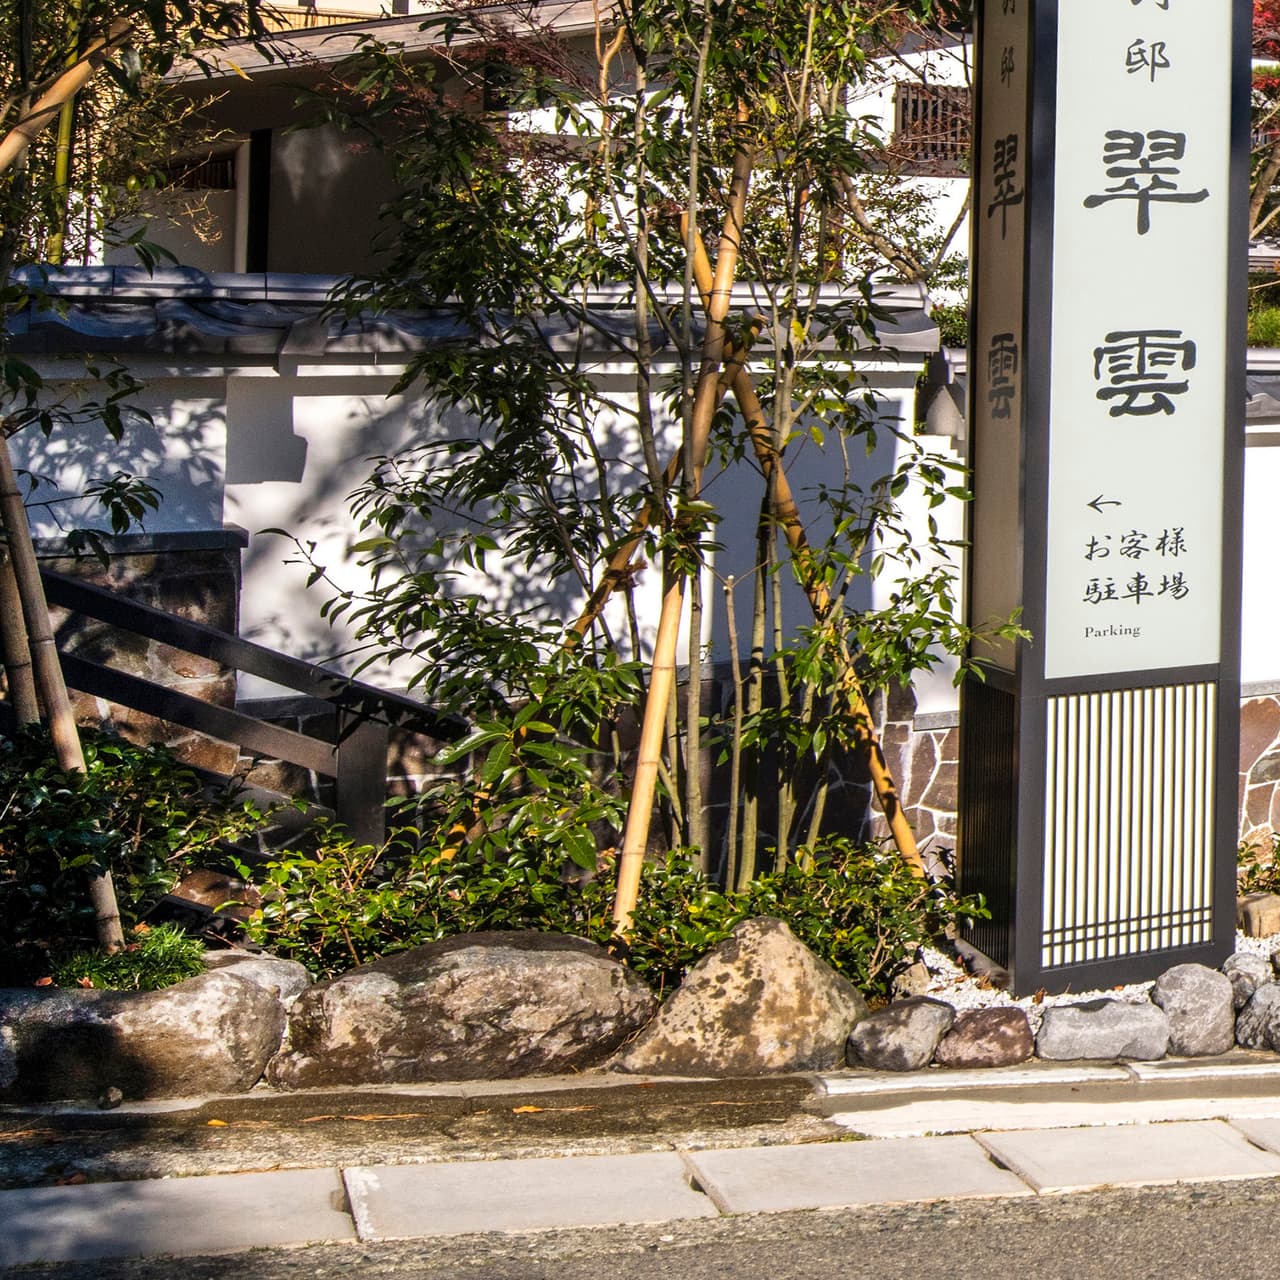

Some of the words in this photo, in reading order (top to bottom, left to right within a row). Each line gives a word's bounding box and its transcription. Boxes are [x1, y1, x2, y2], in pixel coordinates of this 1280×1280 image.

[1083, 129, 1210, 418] 翠雲
[1084, 527, 1187, 561] お客様
[1082, 571, 1190, 605] 駐車場
[1085, 624, 1141, 638] Parking
